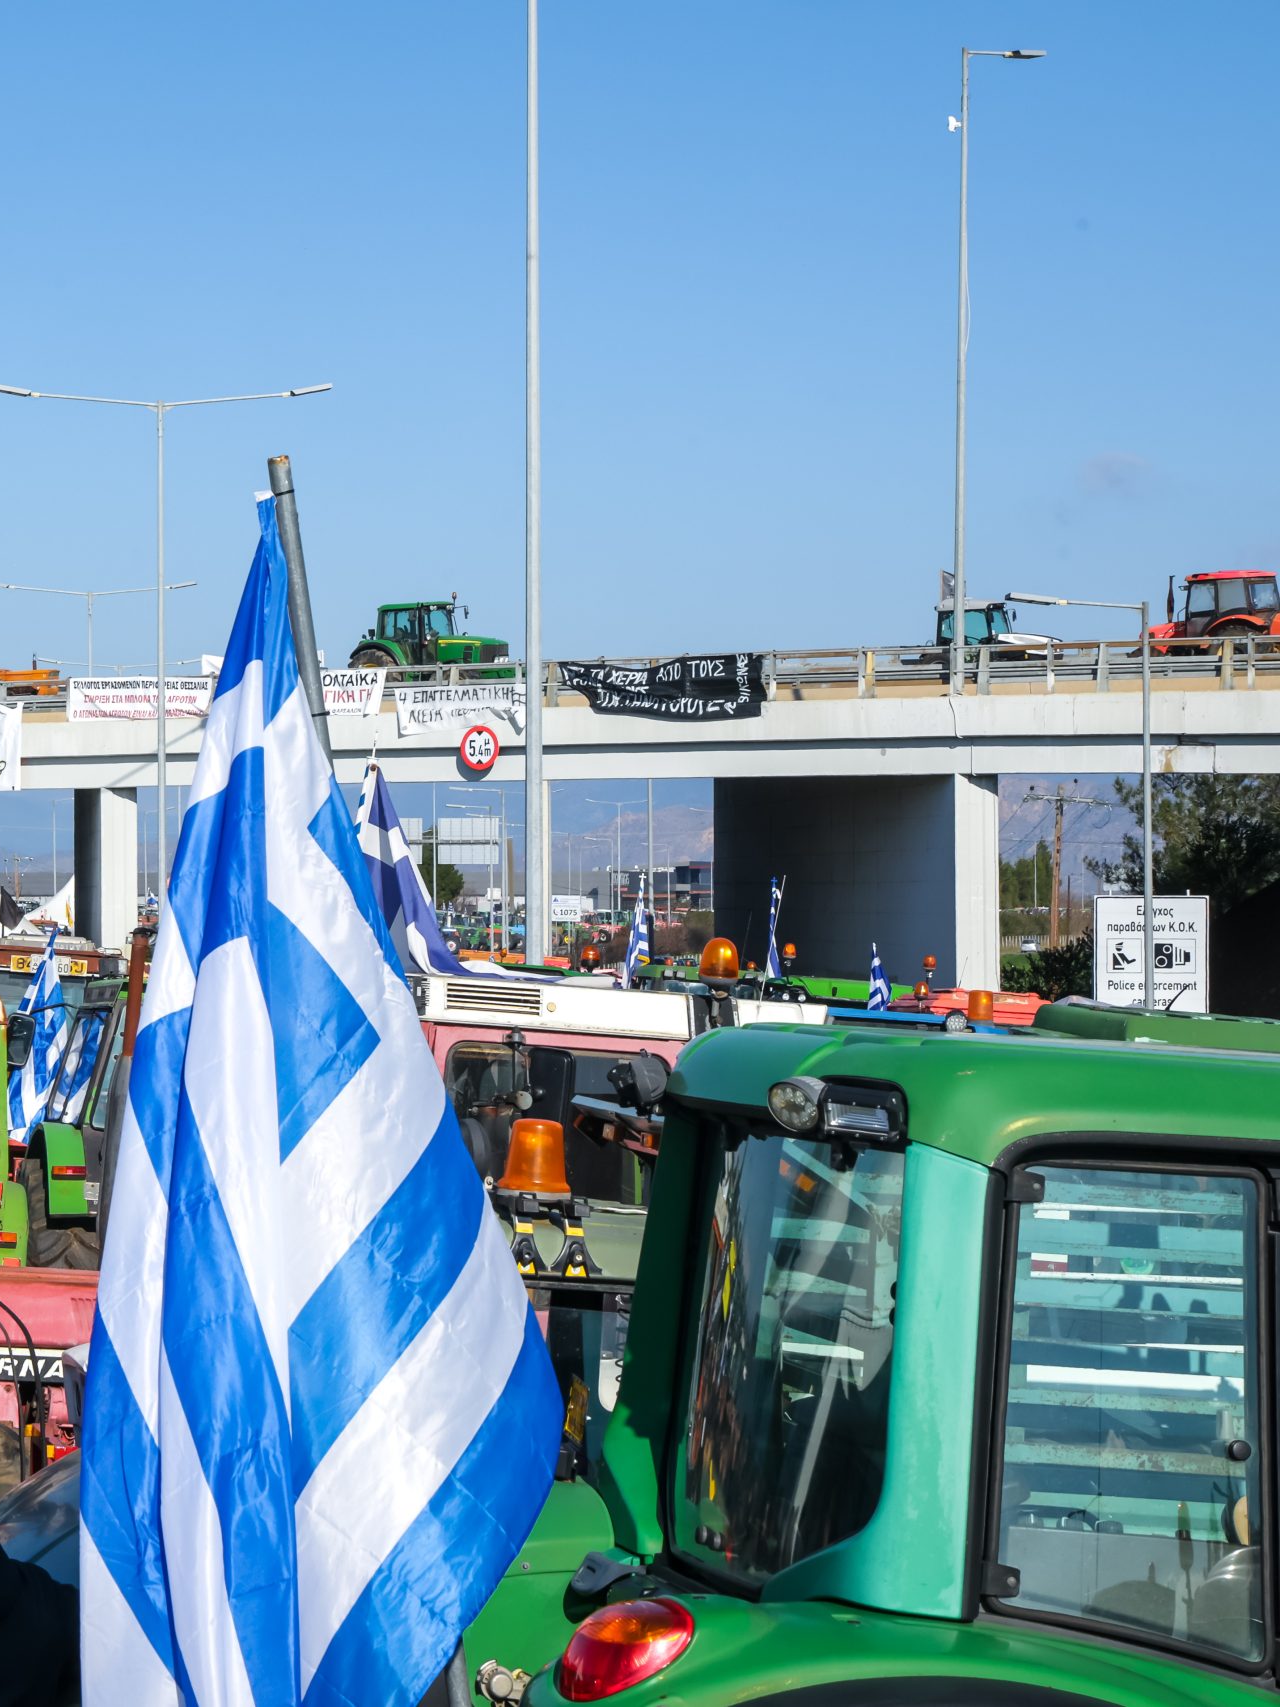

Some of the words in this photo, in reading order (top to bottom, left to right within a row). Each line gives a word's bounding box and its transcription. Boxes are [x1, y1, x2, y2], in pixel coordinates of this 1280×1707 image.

[656, 663, 681, 682] ΑΠΟ
[687, 660, 725, 678] ΤΟΥΣ
[101, 681, 140, 690] ΕΡΓΑΖΟΜΕΝΩΝ
[141, 681, 179, 690] ΠΕΡΙΦΡΕΙΑΣ
[180, 681, 208, 690] ΘΕΣΣΑΛΙΑΣ
[323, 671, 378, 687] ΟΛΤΑΪΚΑ
[324, 690, 355, 703] ΓΙΚΗ
[413, 686, 510, 703] ΕΠΑΓΓΕΛΜΑΤΙΚΗ
[1136, 905, 1174, 917] Εγχος
[1107, 922, 1166, 935] παραβάσων
[1107, 980, 1135, 991] Police
[1138, 981, 1197, 991] eorcement
[1132, 998, 1173, 1007] caeras
